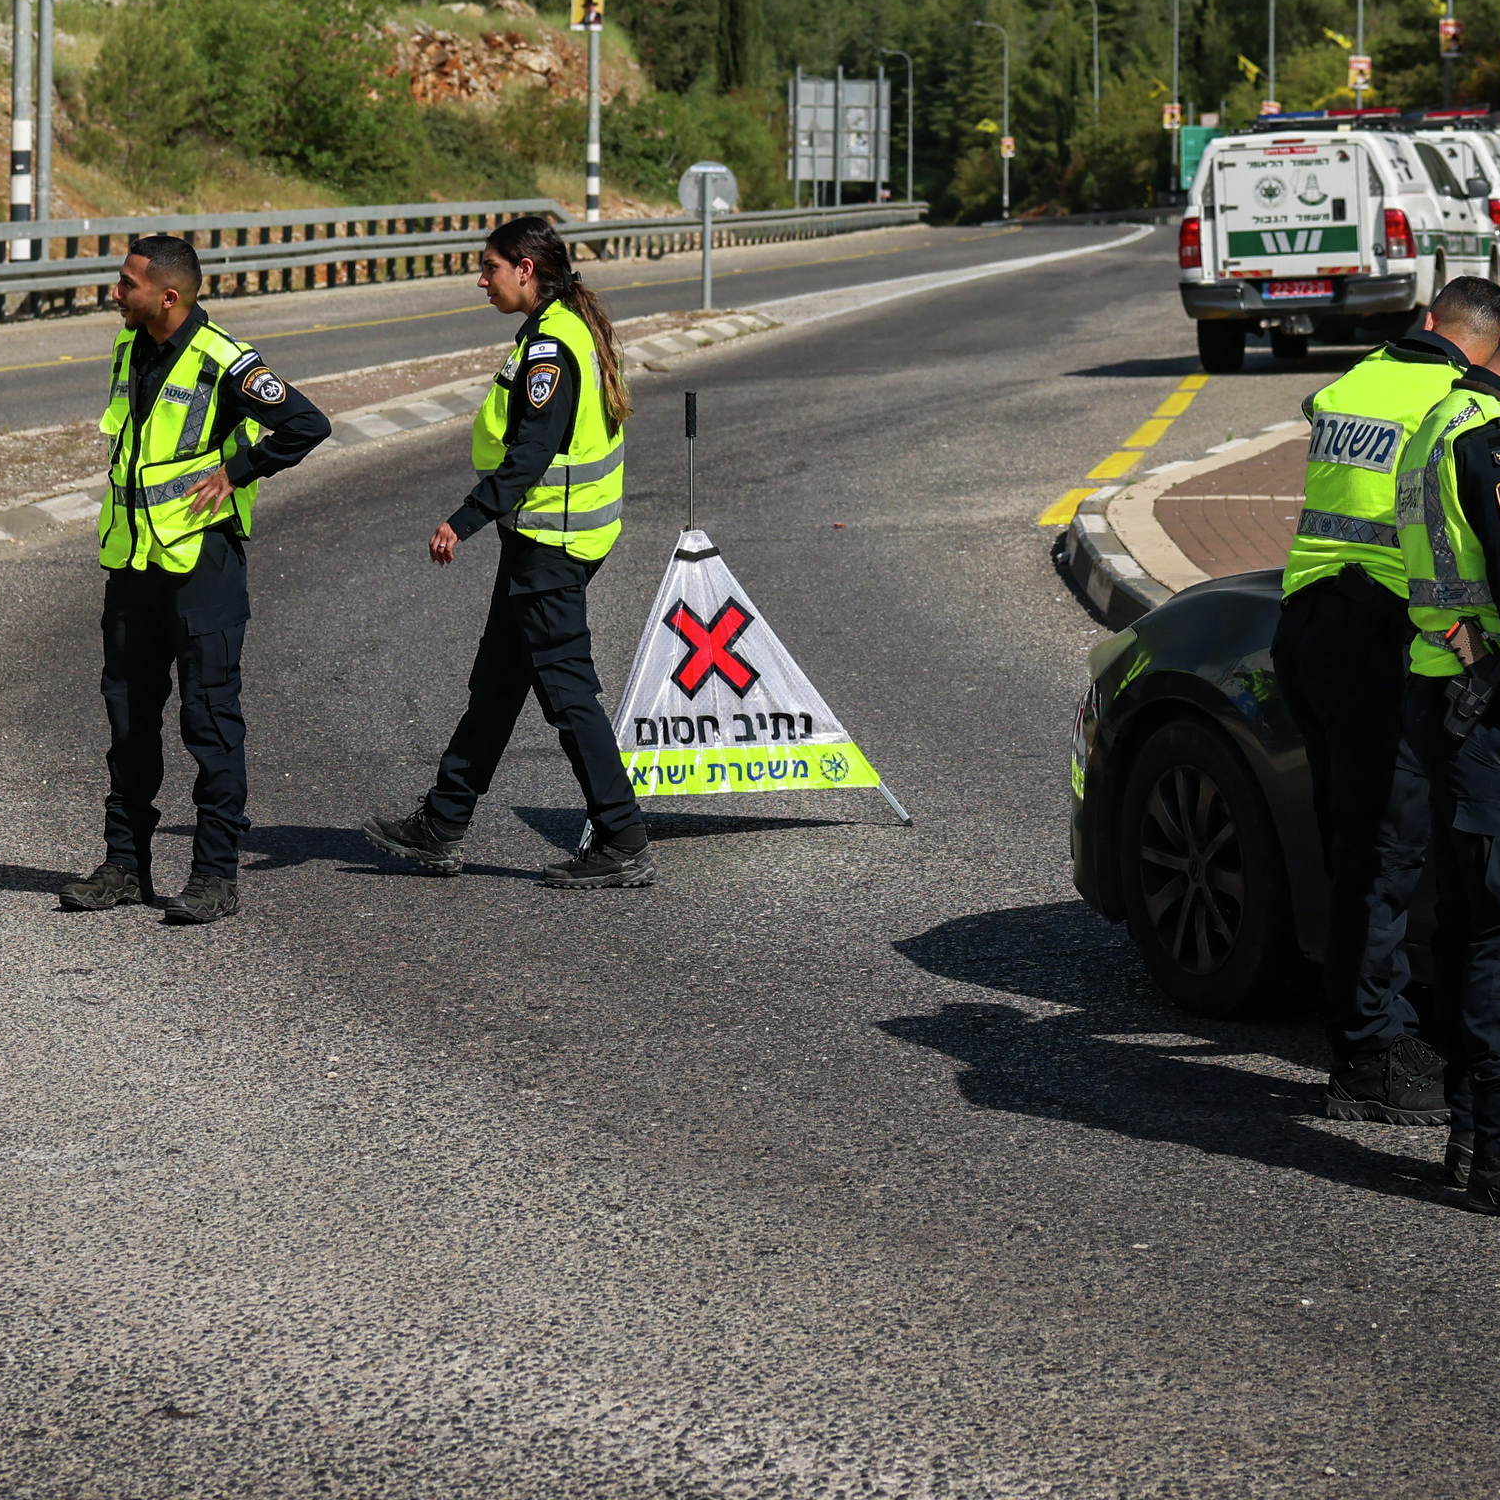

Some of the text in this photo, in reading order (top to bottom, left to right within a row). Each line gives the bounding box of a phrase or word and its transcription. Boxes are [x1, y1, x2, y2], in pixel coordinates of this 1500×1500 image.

[633, 712, 813, 747] נתיב חסום
[631, 759, 808, 786] משטרת ישרא
